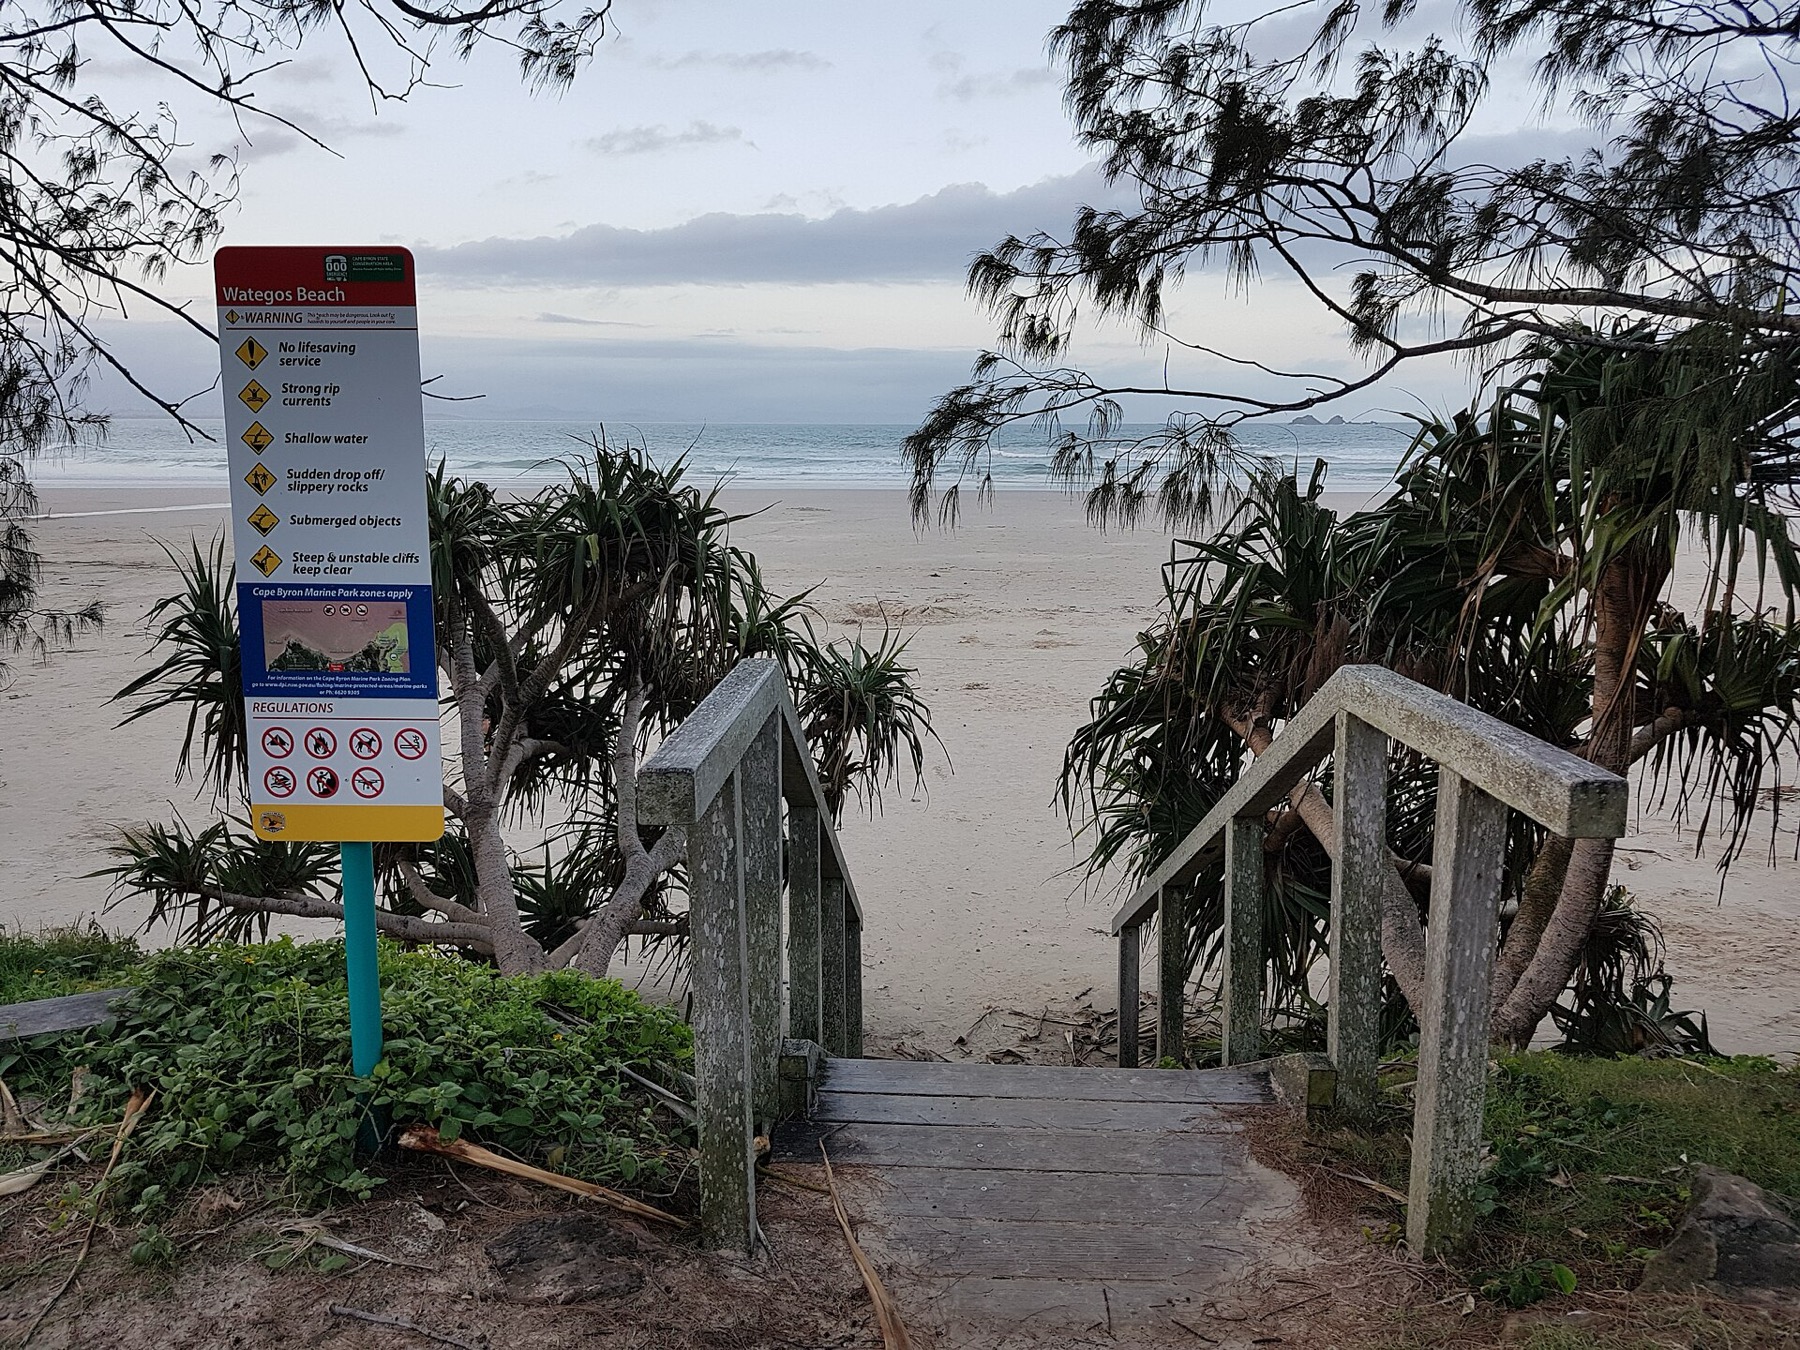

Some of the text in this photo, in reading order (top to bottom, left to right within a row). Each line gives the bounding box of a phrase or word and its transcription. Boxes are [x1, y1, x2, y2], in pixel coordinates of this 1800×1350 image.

[326, 262, 347, 271] 000
[223, 286, 345, 304] Wategos Beach
[245, 312, 303, 324] WARNING
[279, 342, 356, 355] No lifesaving
[279, 356, 321, 366] service
[281, 383, 340, 396] Strong rip
[282, 397, 331, 406] currents
[285, 432, 368, 444] Shallow water
[287, 469, 385, 482] Sudden drop off/
[288, 481, 368, 494] slippery rocks
[290, 515, 401, 528] Submerged objects
[292, 552, 419, 564] Steep & unstable cliffs
[293, 564, 352, 577] keep clear
[253, 588, 276, 597] Cape
[277, 588, 303, 598] Byron
[304, 588, 336, 597] Marine
[388, 589, 413, 599] apply
[252, 702, 333, 713] REGULATIONS
